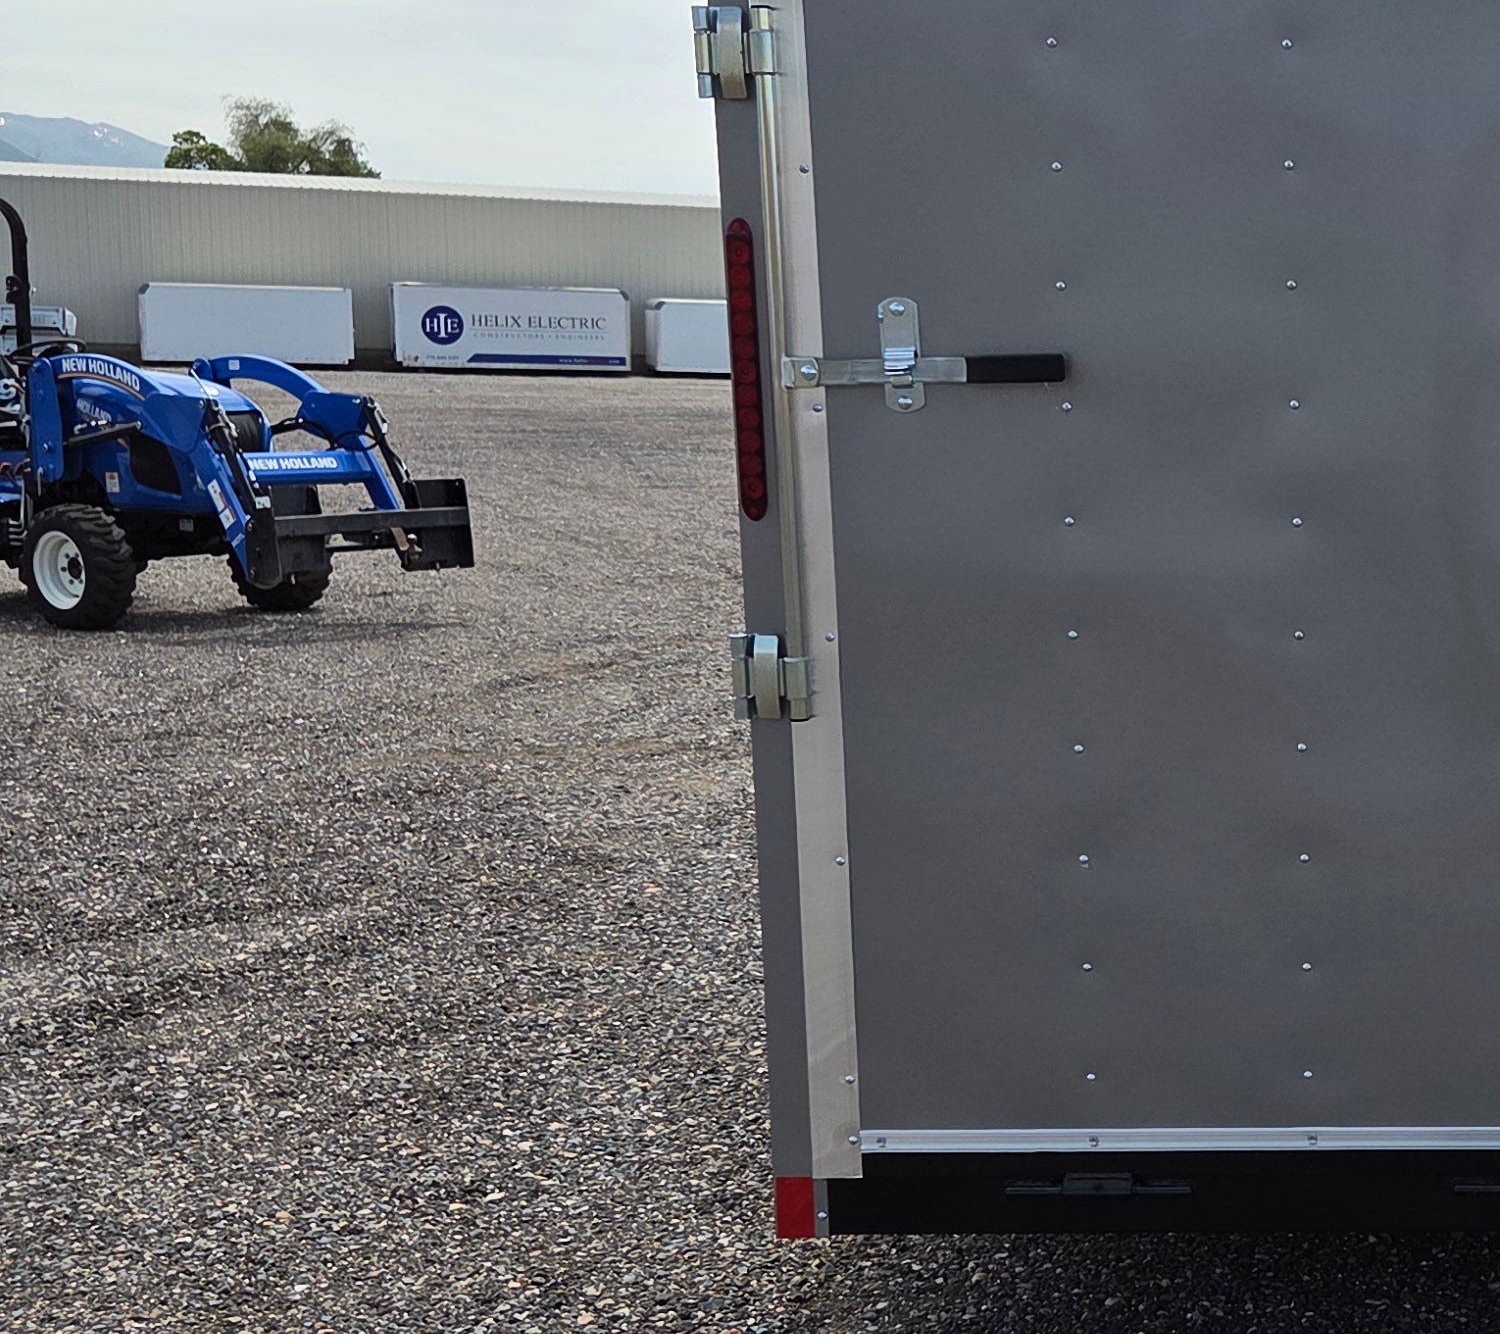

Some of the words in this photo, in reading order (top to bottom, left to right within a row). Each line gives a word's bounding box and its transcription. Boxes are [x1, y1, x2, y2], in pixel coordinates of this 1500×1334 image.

[471, 313, 522, 328] HELIX
[528, 315, 607, 330] ELECTRIC
[62, 357, 87, 373] NEW
[88, 358, 140, 392] HOLLAND
[247, 458, 279, 470] NEW
[279, 457, 338, 470] HOLLAND
